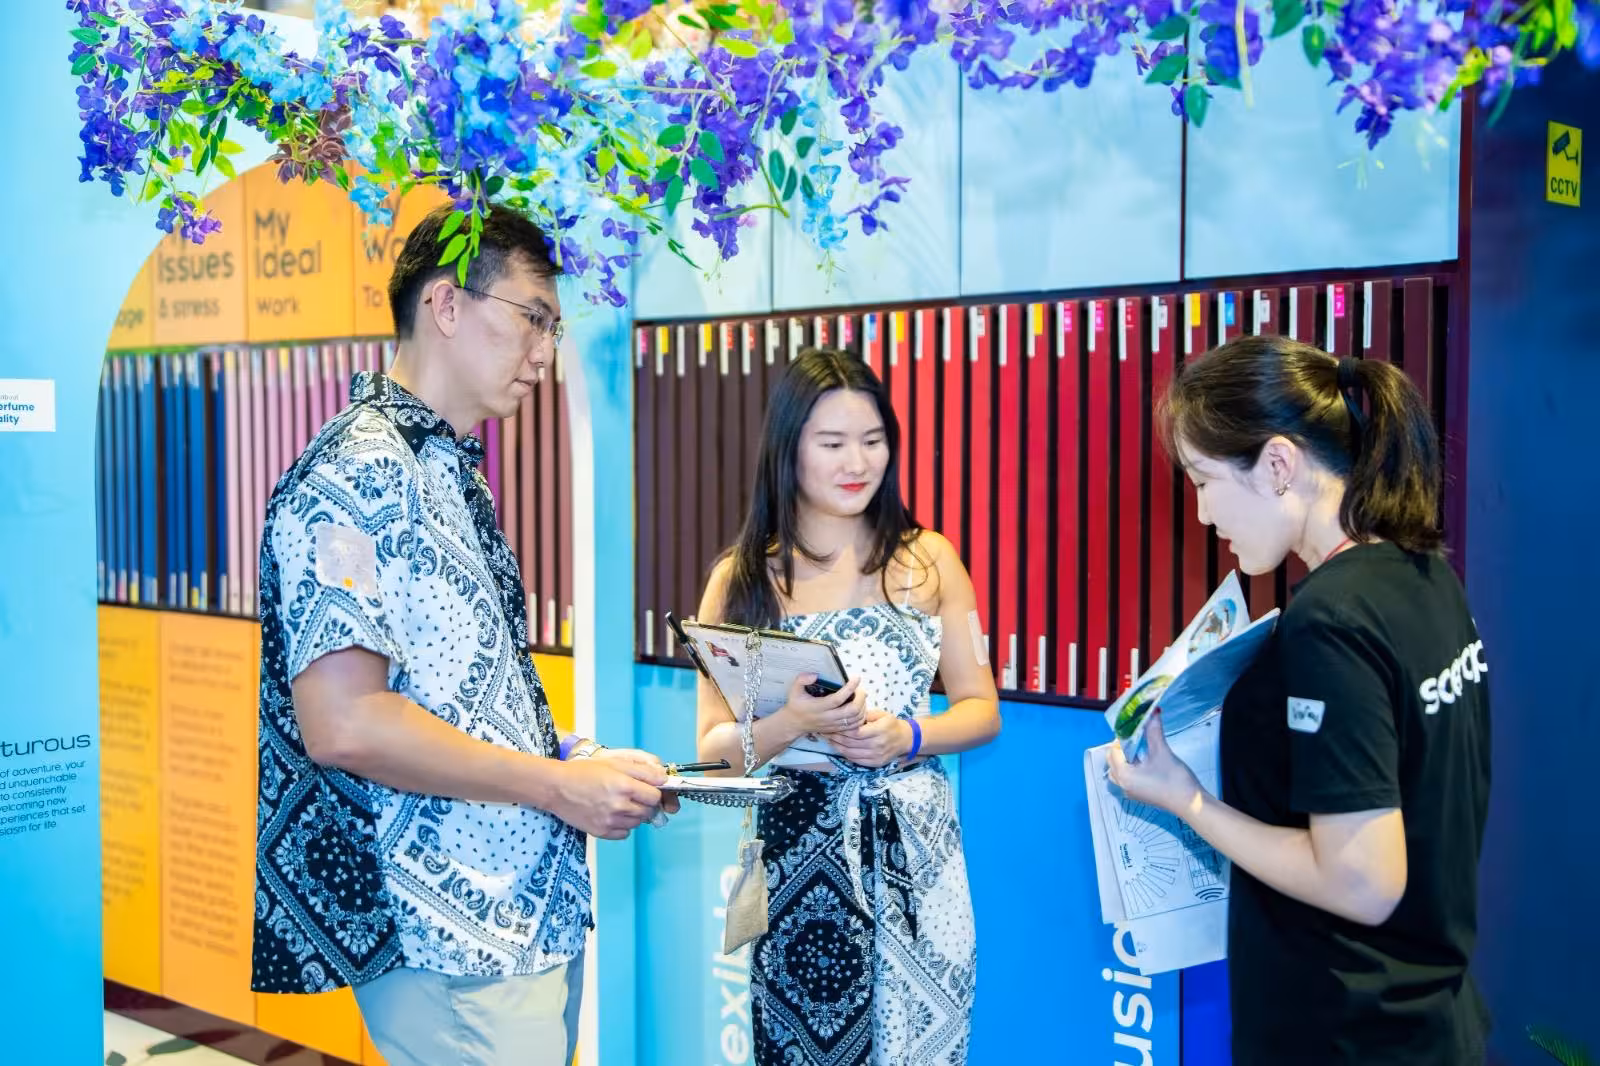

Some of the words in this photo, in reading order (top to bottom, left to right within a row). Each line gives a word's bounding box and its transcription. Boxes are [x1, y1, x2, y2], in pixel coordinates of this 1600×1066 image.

[1550, 176, 1578, 198] CCTV
[254, 208, 290, 246] My
[157, 250, 235, 285] Issues
[255, 239, 322, 279] Ideal
[0, 402, 35, 411] erfume
[0, 734, 91, 757] turous
[65, 761, 86, 771] your
[8, 773, 77, 788] unquenchable
[13, 785, 67, 799] consistently
[0, 811, 50, 825] periences
[51, 806, 69, 817] that
[72, 804, 86, 814] set
[29, 823, 41, 832] for
